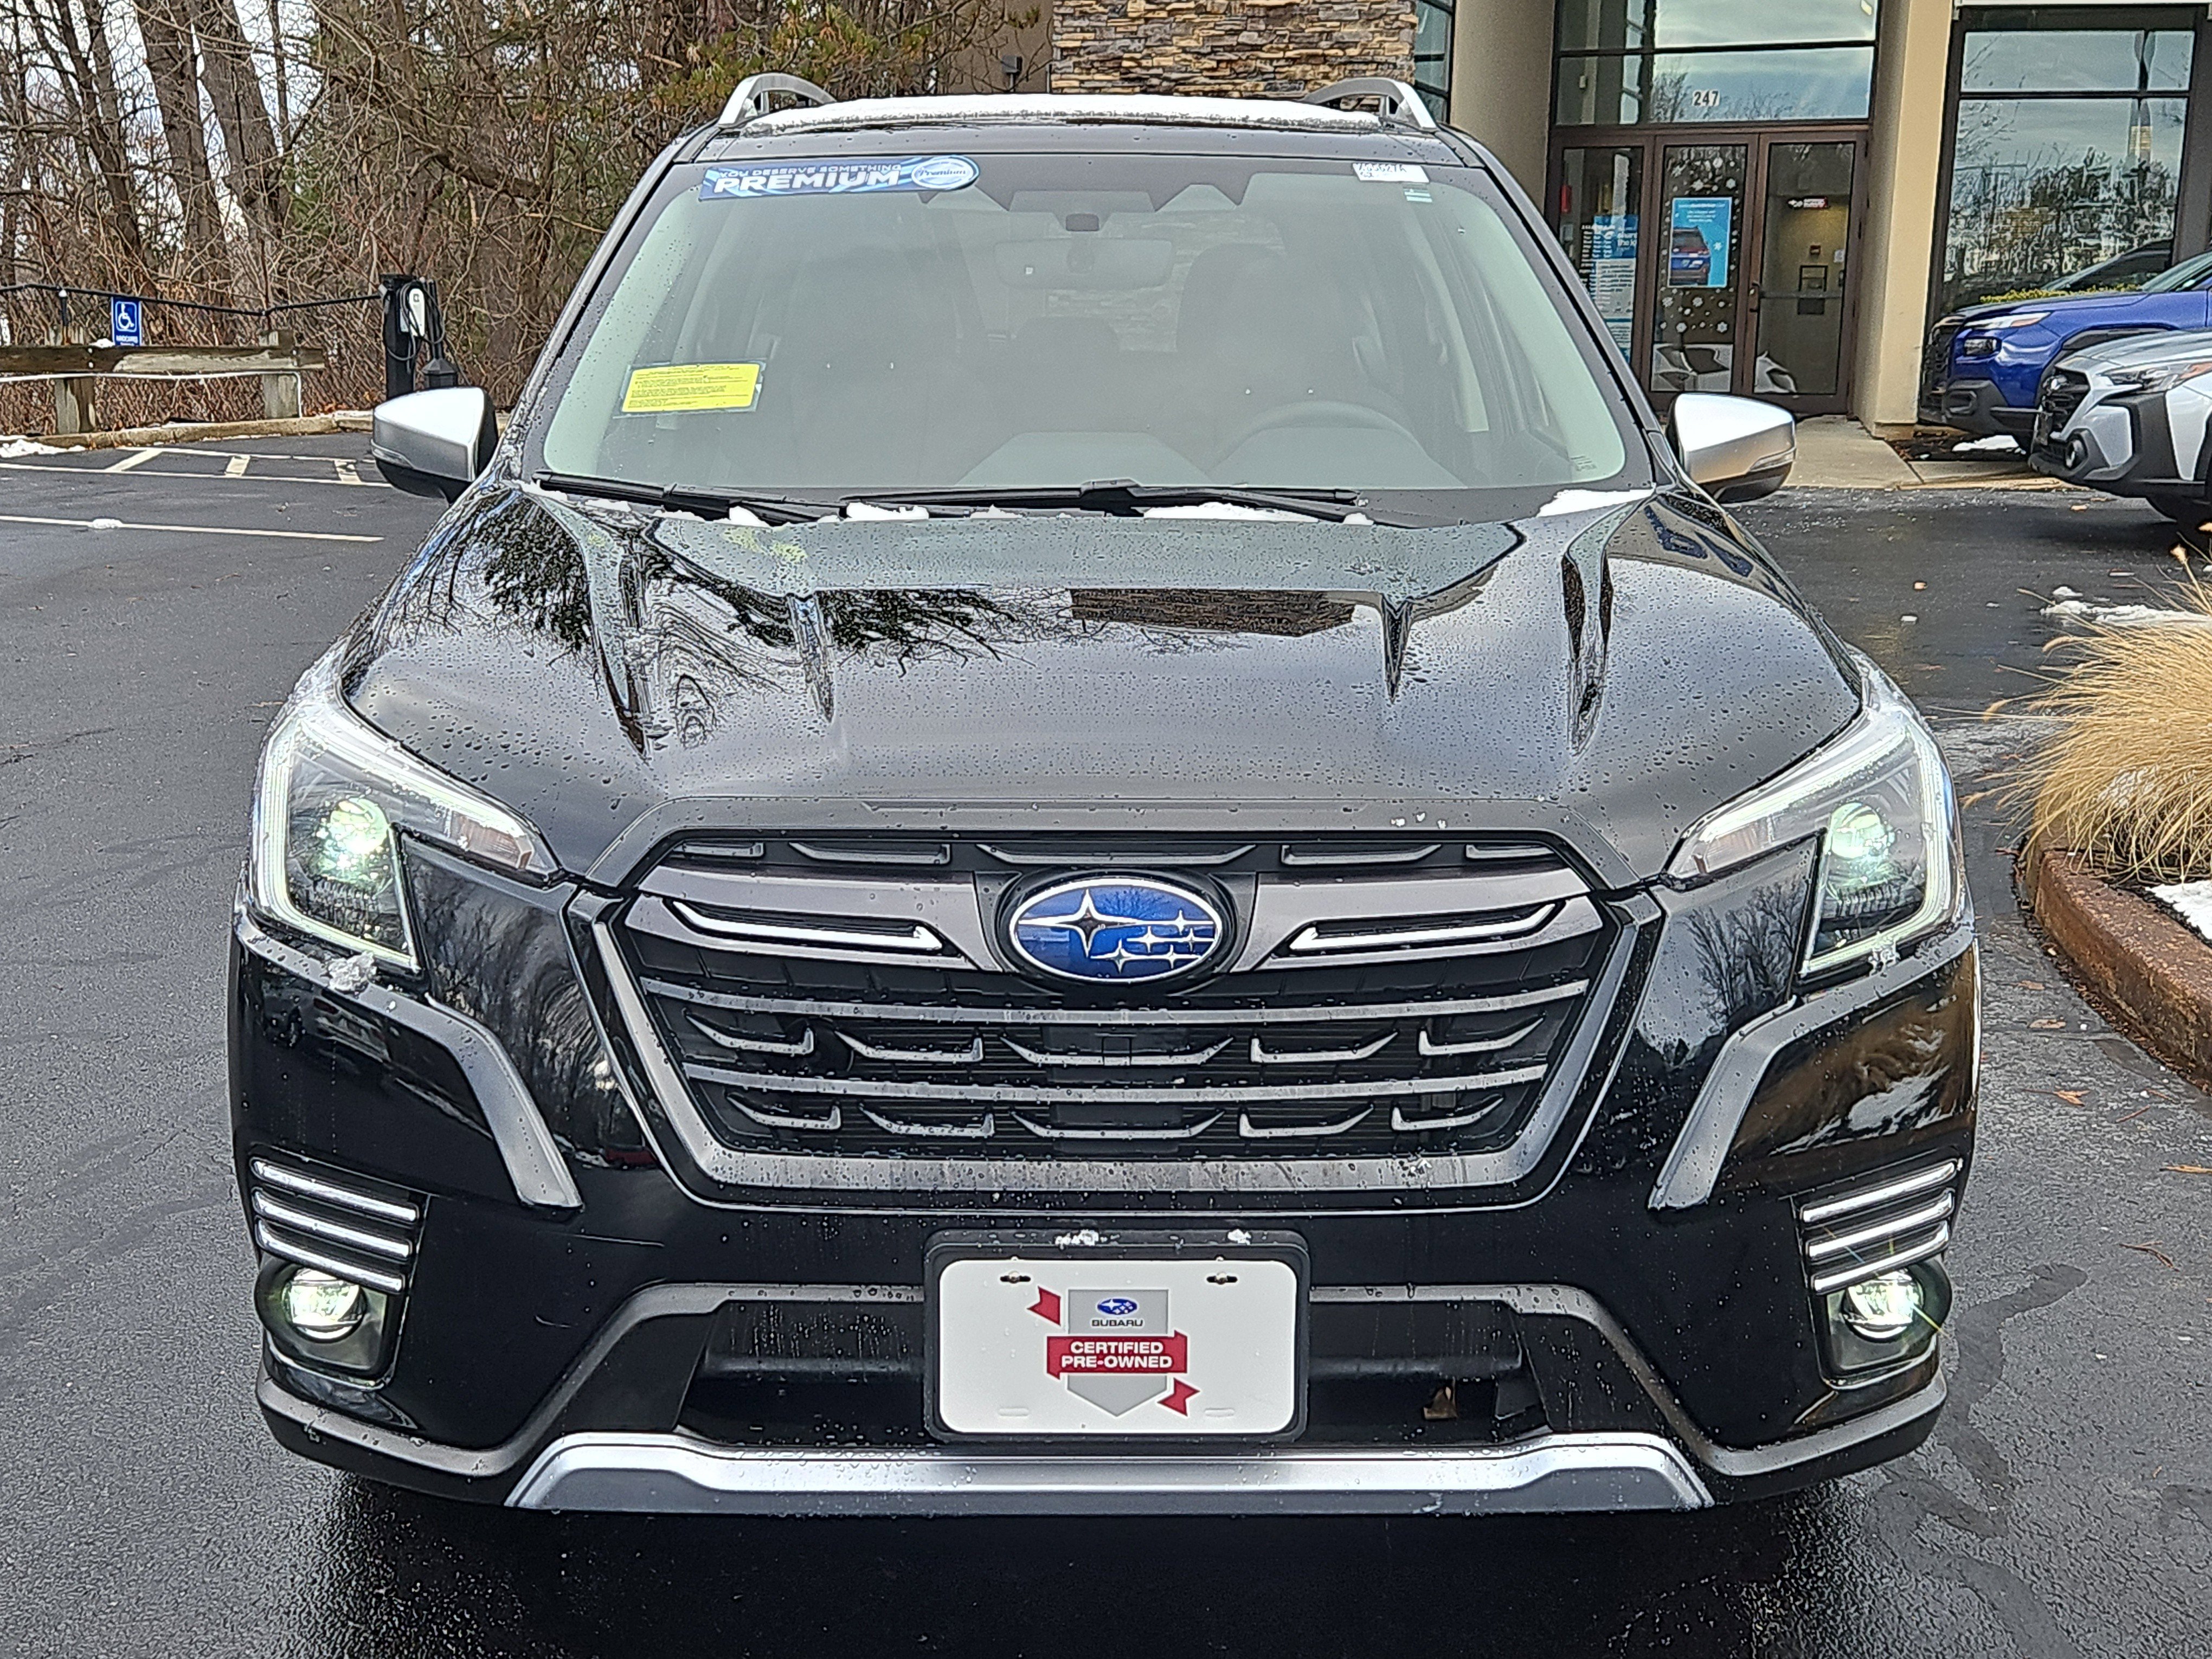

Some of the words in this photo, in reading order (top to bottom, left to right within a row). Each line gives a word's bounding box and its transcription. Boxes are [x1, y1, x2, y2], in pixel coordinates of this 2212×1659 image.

[1694, 90, 1719, 106] 247
[719, 170, 749, 178] YOU
[752, 166, 816, 177] DESERVE
[819, 164, 902, 173] SOMETHING
[714, 170, 900, 194] PREMIUM
[1070, 1341, 1164, 1354] CERTIFIED
[1061, 1355, 1173, 1368] PRE-OWNED
